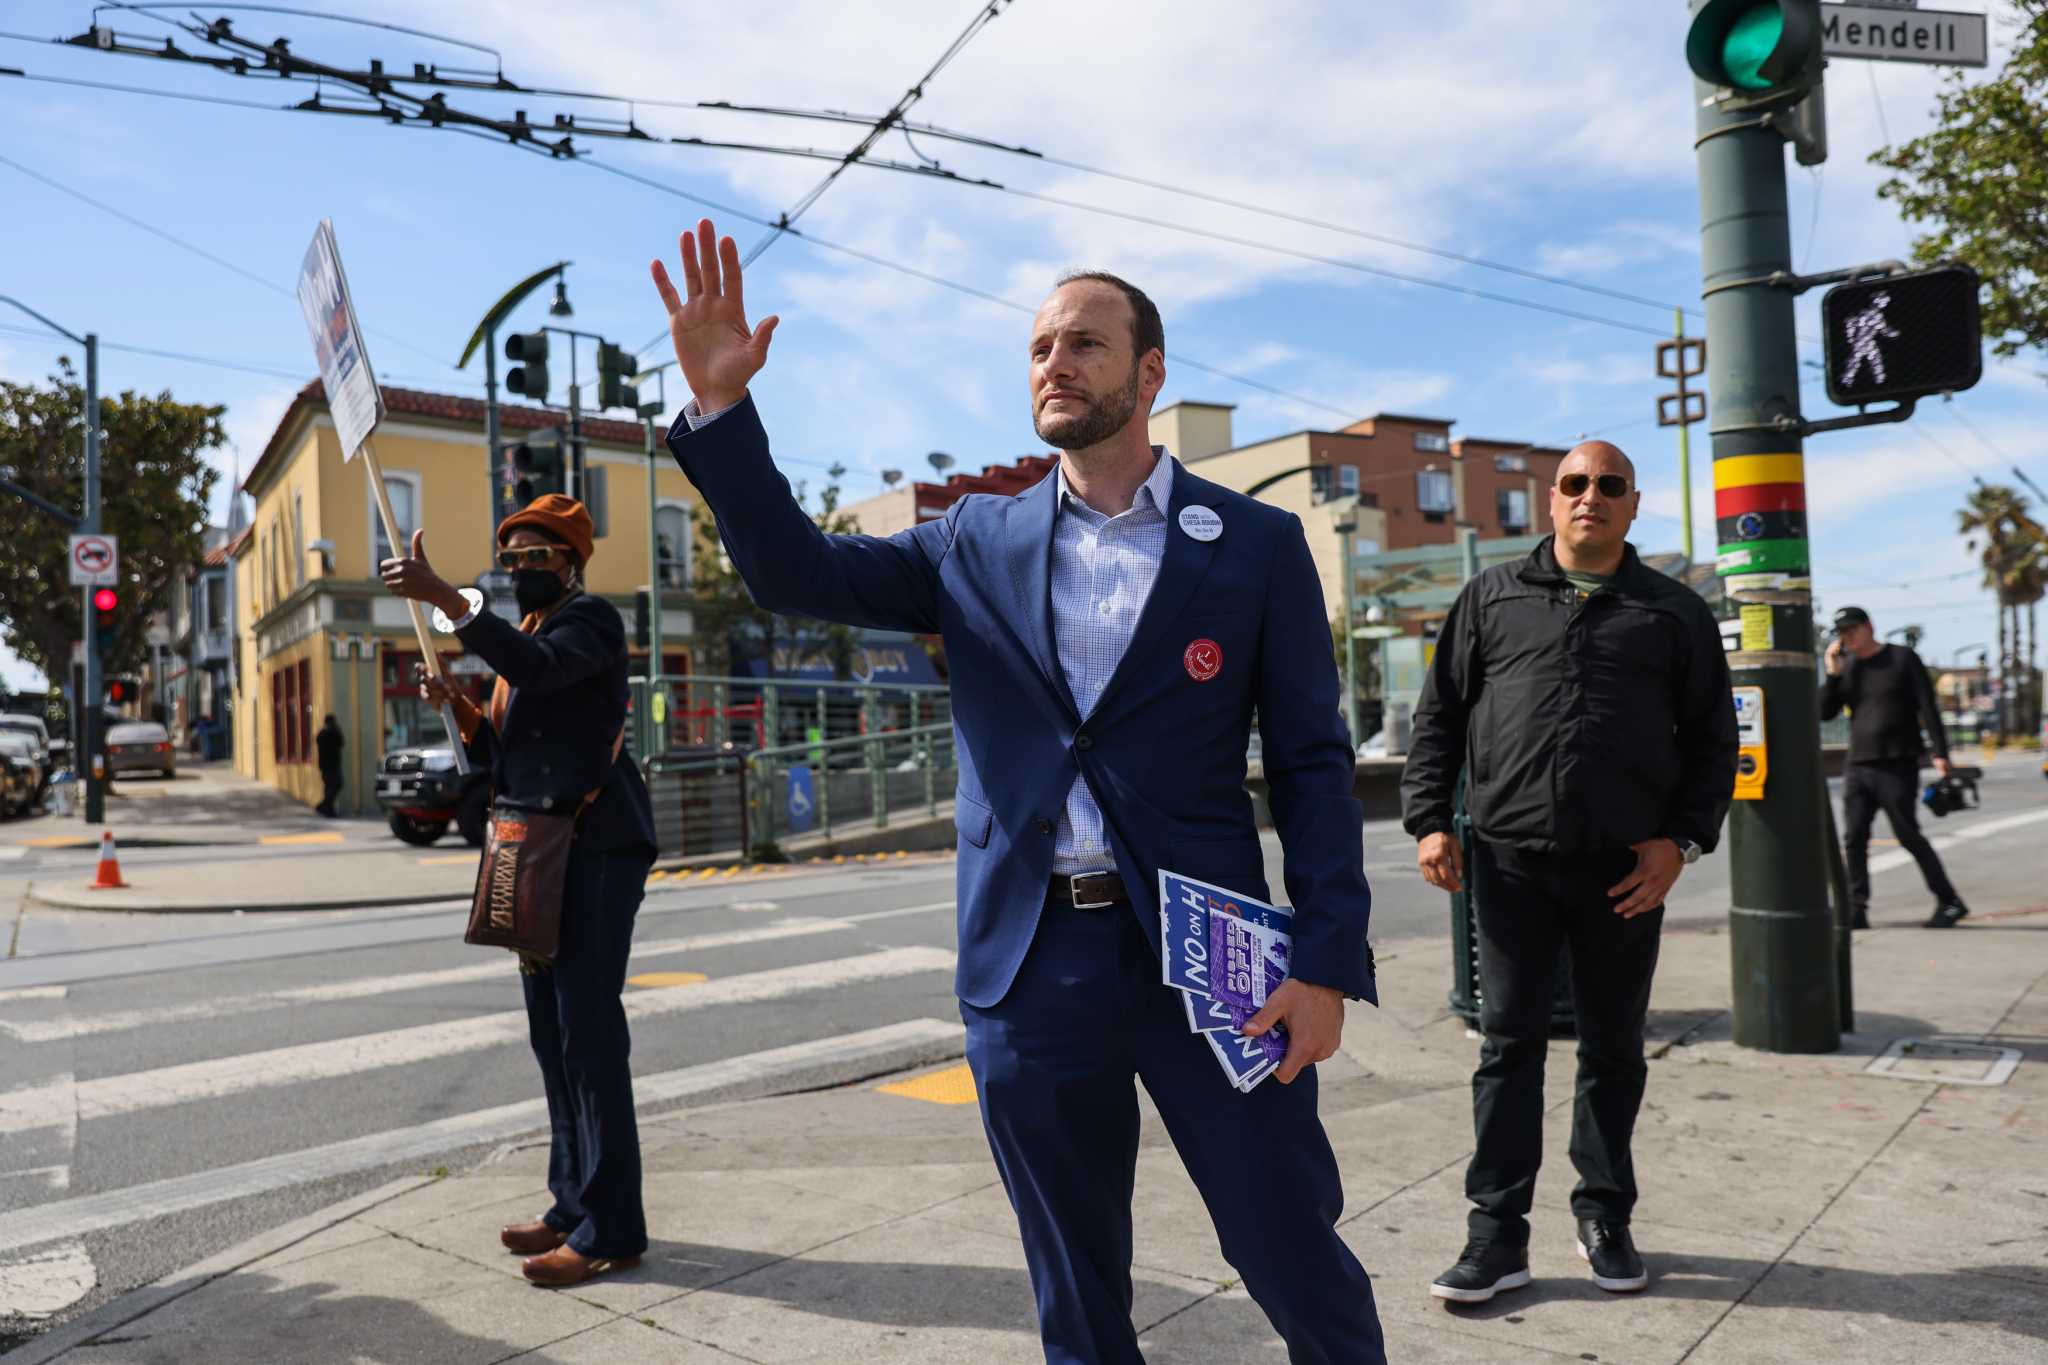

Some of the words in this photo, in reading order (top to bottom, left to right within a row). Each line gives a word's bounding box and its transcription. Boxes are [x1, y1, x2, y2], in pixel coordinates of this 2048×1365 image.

[1822, 14, 1955, 51] Mendell
[1181, 884, 1207, 914] H
[1191, 912, 1203, 936] ON
[1184, 937, 1209, 988] NO
[1226, 919, 1237, 992] PISSED
[1235, 926, 1251, 995] OFF
